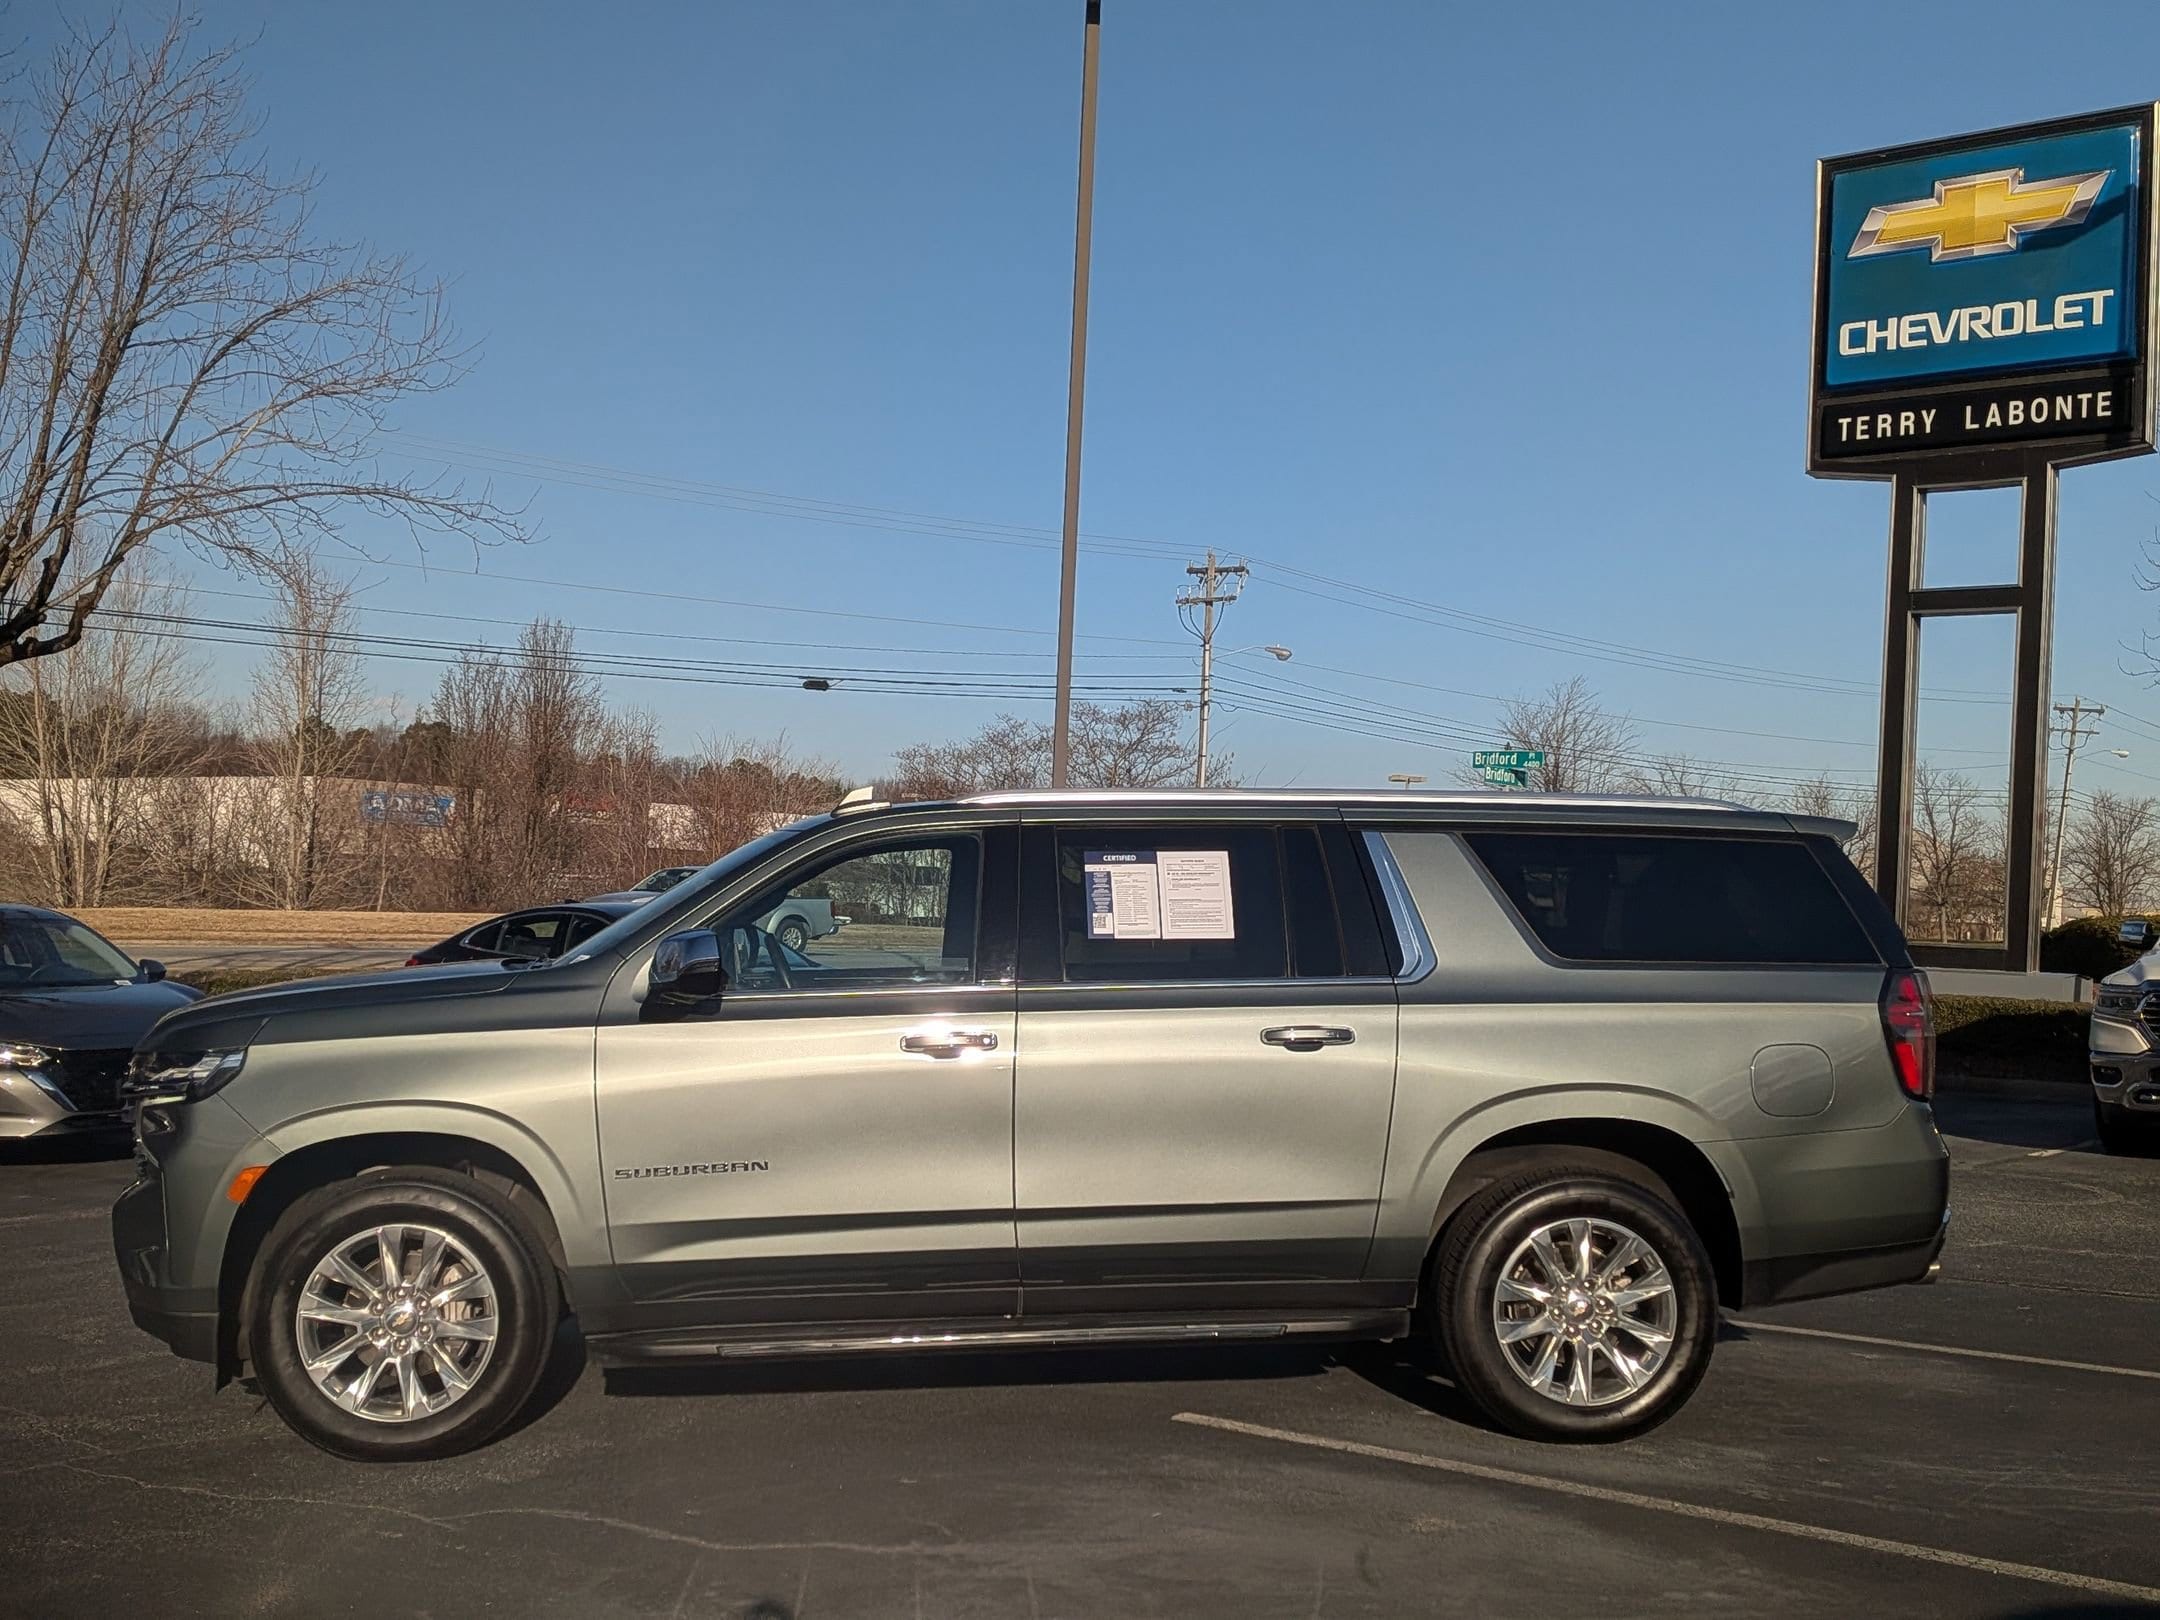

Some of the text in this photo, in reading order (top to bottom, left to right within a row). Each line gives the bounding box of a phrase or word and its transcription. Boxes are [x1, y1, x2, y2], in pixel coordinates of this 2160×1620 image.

[1838, 288, 2115, 357] CHEVROLET
[1837, 390, 2114, 442] TERRY LABONTE
[1475, 752, 1517, 765] Bridford
[1103, 854, 1137, 862] CERTIFIED
[614, 1160, 769, 1180] SUBURBAN
